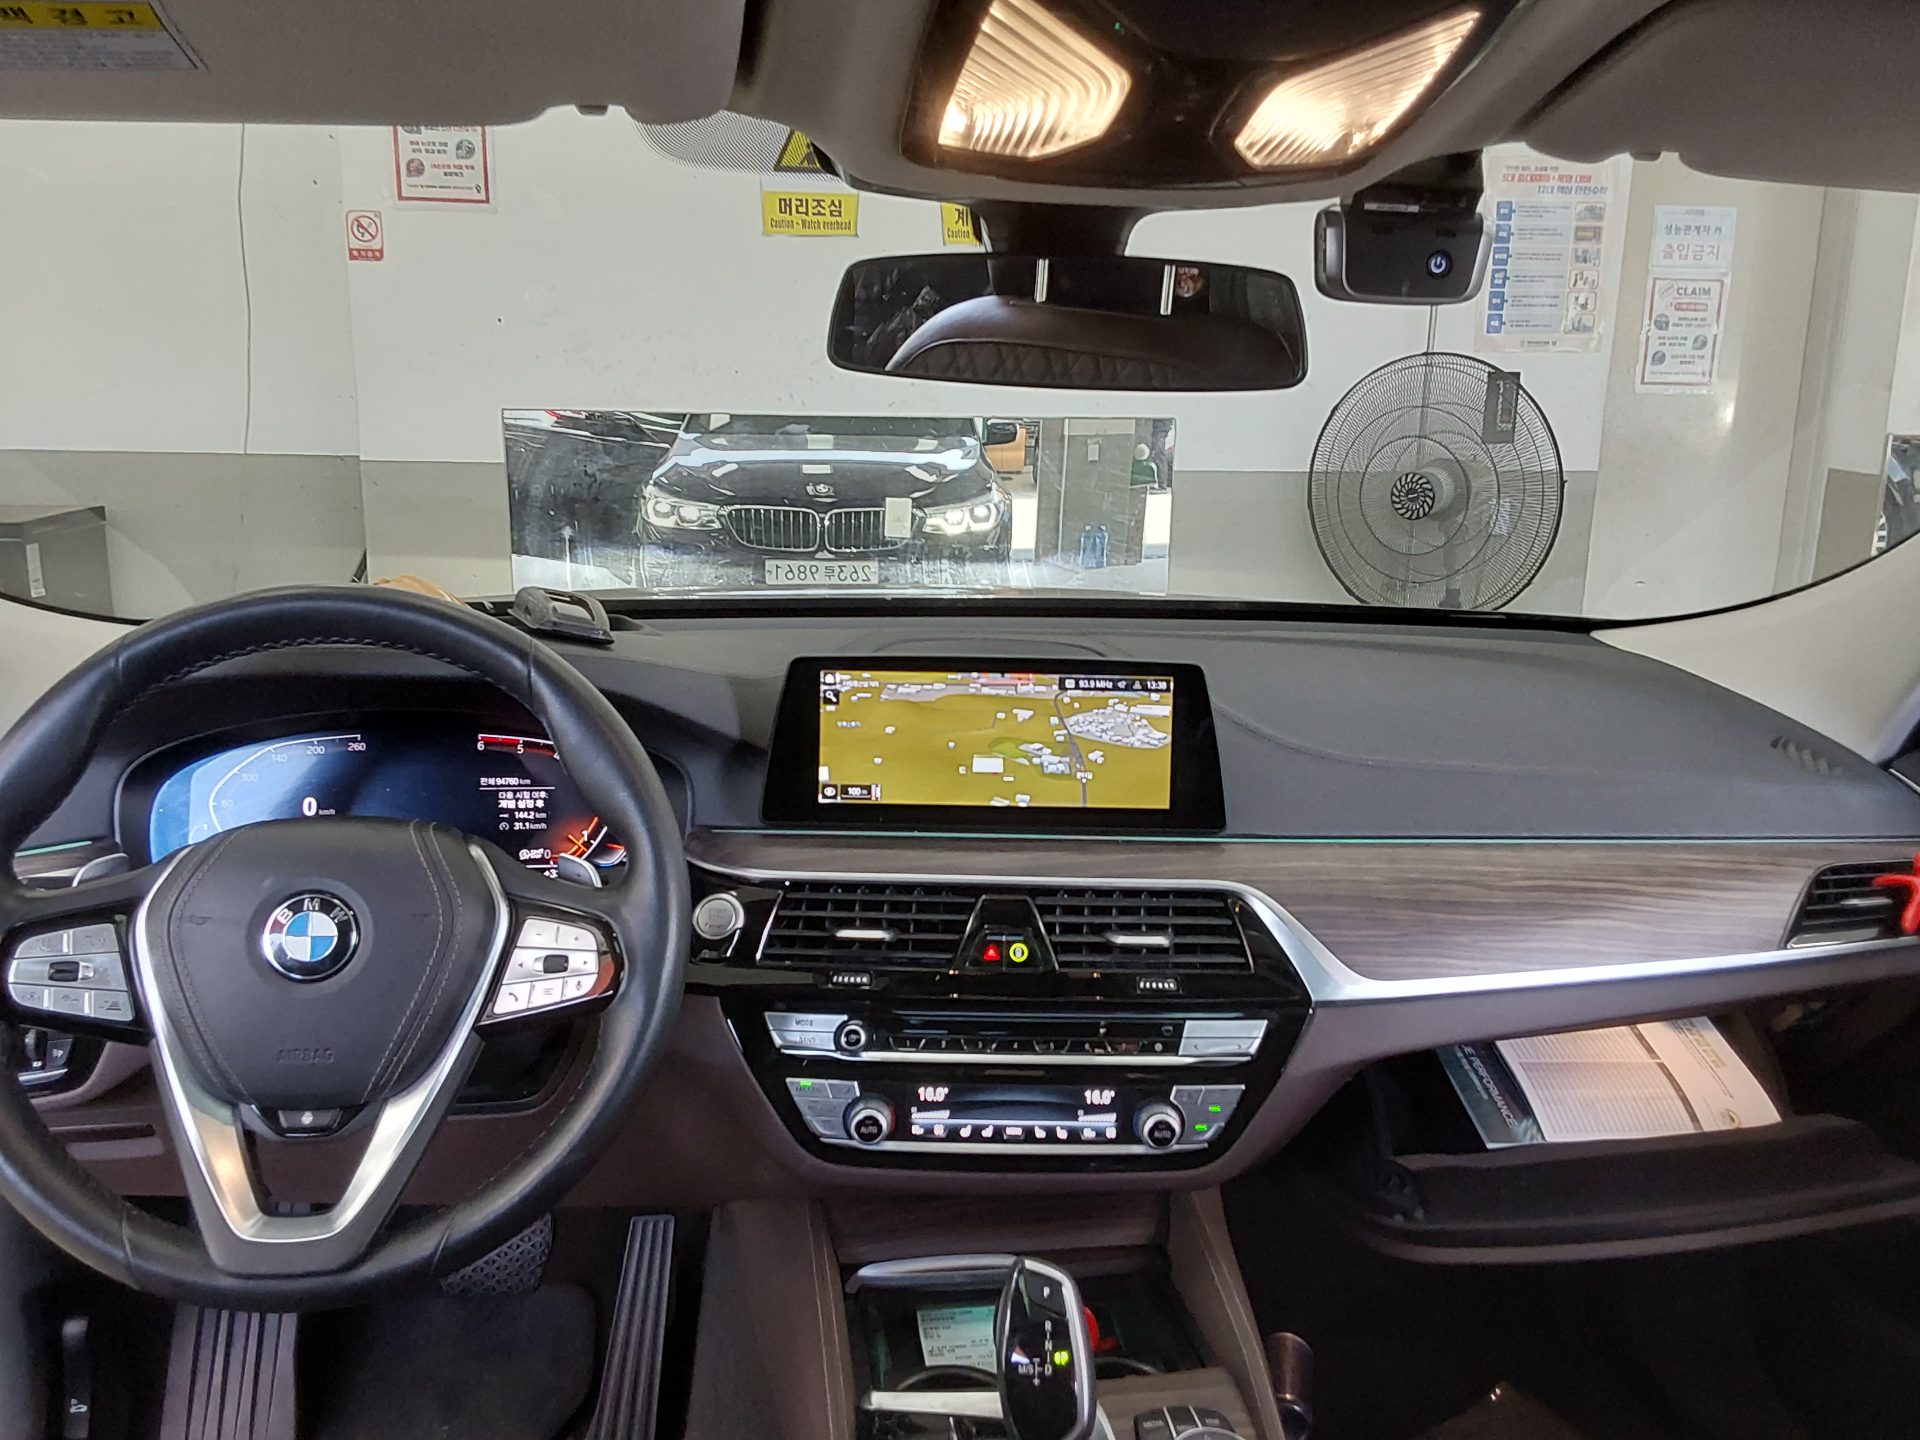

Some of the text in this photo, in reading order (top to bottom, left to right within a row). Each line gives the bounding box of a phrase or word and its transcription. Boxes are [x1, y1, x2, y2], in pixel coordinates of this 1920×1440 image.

[778, 197, 842, 217] 머리조심
[954, 207, 969, 226] 계
[770, 218, 794, 229] Caution
[947, 227, 970, 239] Caution
[1662, 243, 1720, 261] 출입금지
[1676, 287, 1711, 296] CLAIM
[306, 745, 325, 755] 200
[347, 742, 366, 751] 260
[477, 741, 485, 751] 6
[516, 744, 524, 754] 5
[271, 754, 288, 762] 140
[495, 777, 520, 786] 94760
[302, 796, 318, 816] 0
[514, 811, 535, 819] 144.2
[513, 821, 547, 830] 31.1 km/h
[276, 898, 348, 924] BMW
[1043, 1286, 1051, 1298] P
[1044, 1320, 1052, 1333] R
[1045, 1339, 1053, 1352] N
[1044, 1363, 1052, 1376] D
